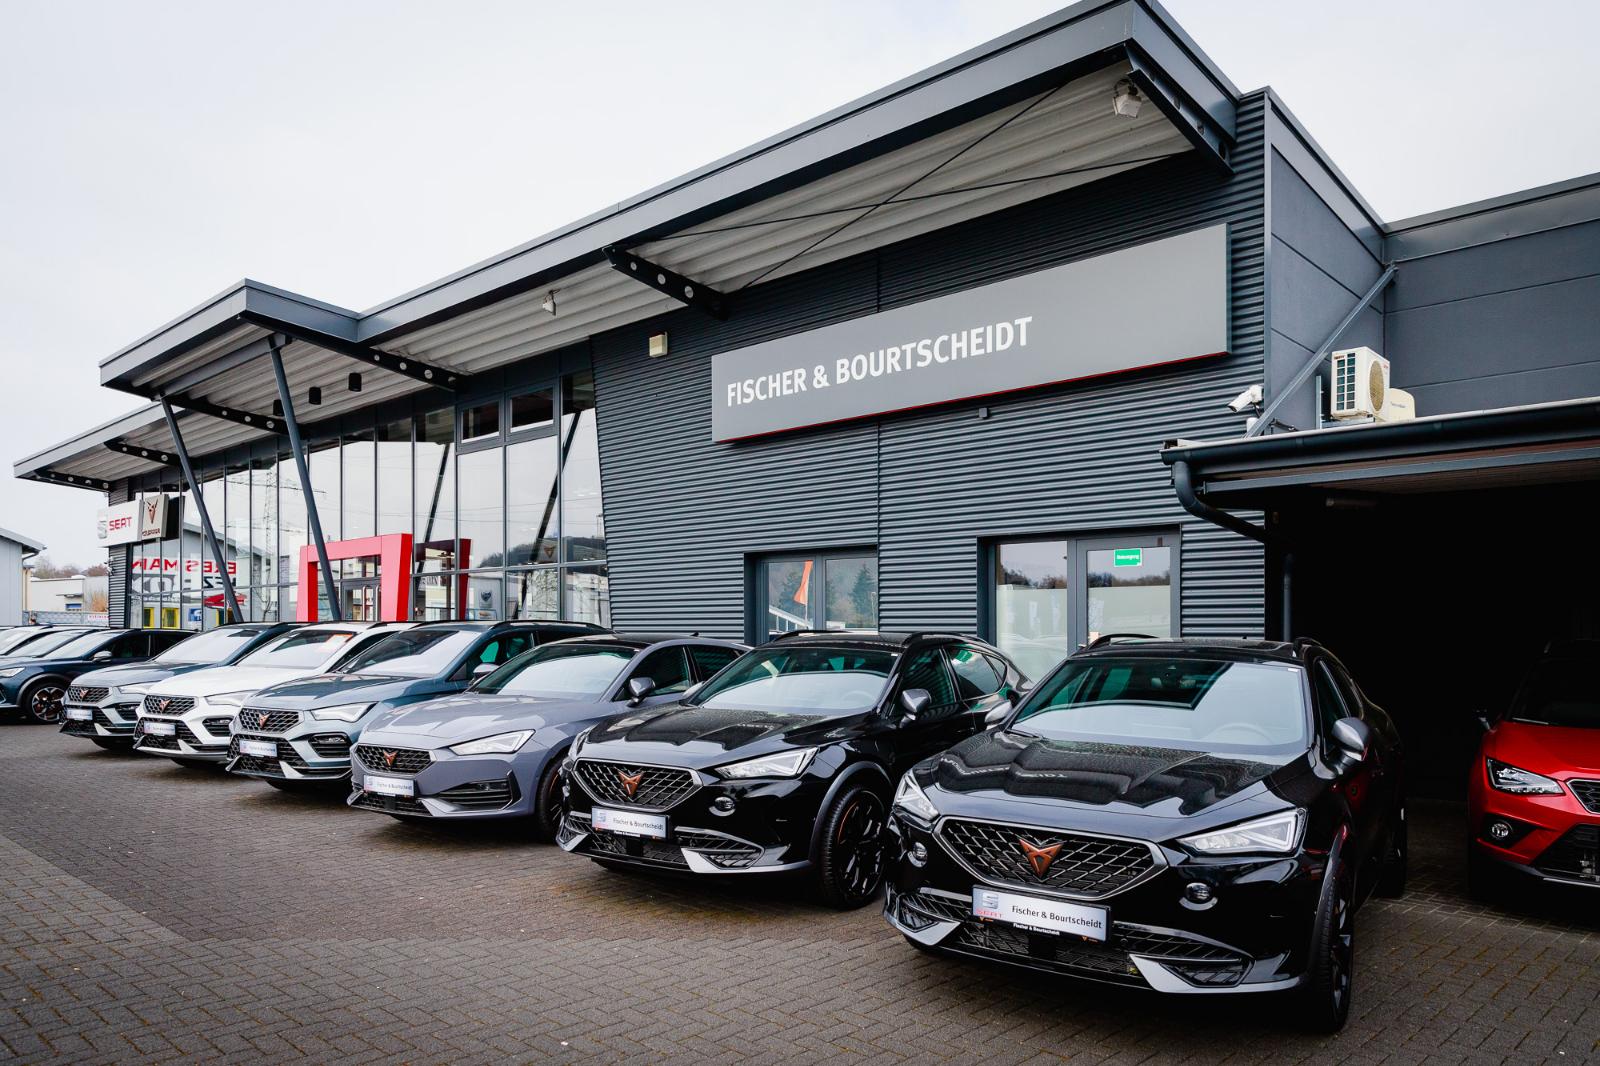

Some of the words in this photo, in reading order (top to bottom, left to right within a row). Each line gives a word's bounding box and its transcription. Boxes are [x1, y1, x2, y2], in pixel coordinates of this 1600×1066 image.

[727, 367, 807, 407] FISCHER
[812, 364, 830, 389] &
[836, 316, 1033, 385] BOURTSCHEIDT
[109, 516, 132, 531] SEAT
[1012, 905, 1039, 917] Fischer
[1041, 911, 1047, 919] &
[1049, 912, 1102, 929] Bourtscheidt
